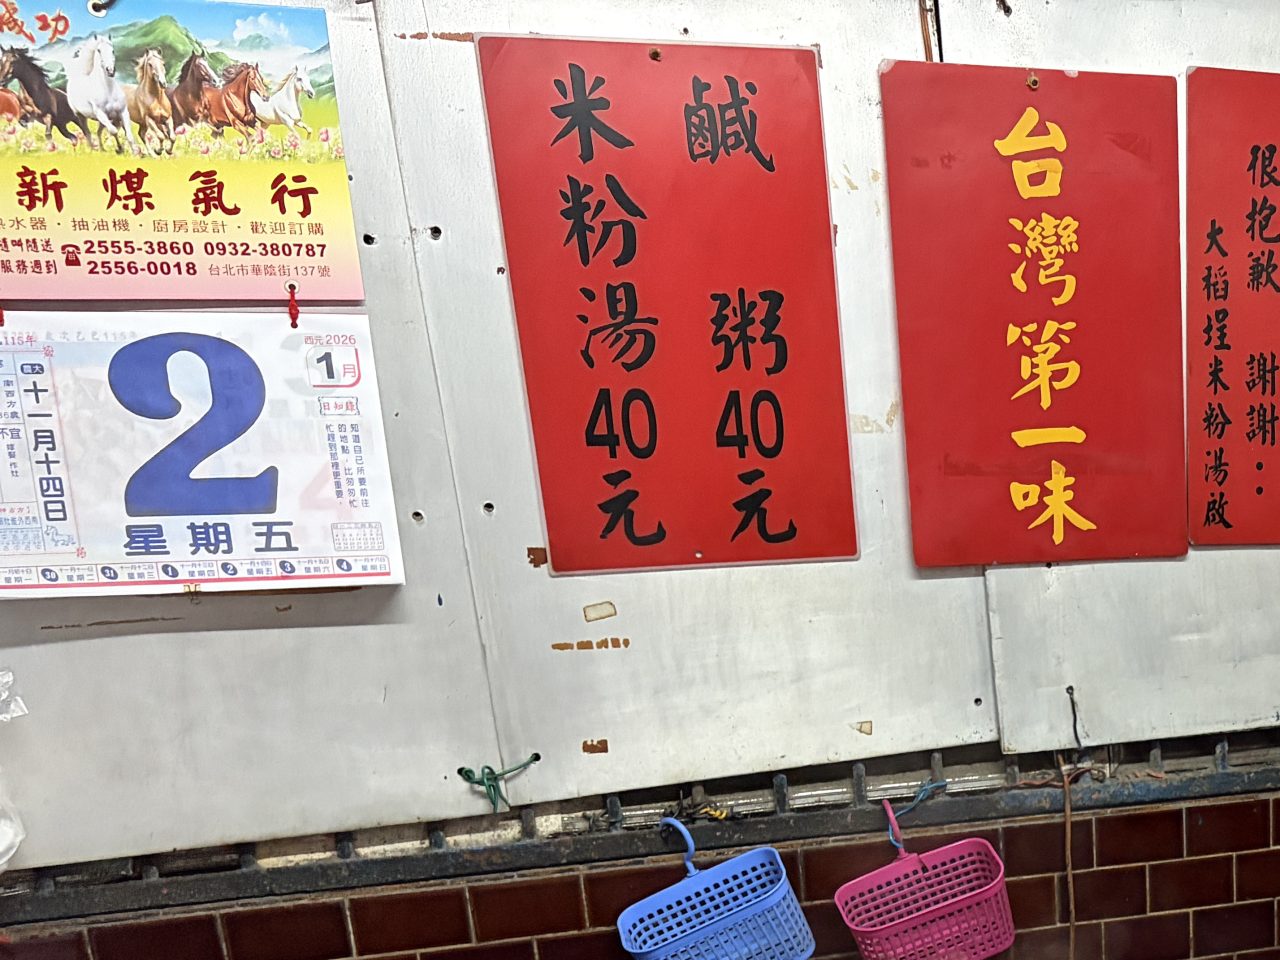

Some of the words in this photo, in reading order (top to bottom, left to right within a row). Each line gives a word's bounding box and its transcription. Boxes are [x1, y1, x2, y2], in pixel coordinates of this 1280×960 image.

[83, 239, 194, 256] 2555-3860
[203, 241, 327, 258] 0932-380787
[86, 260, 198, 276] 2556-0018
[994, 106, 1098, 546] 台灣第一味
[23, 380, 68, 521] 十一月十四日
[108, 331, 278, 517] 2
[124, 521, 300, 556] 星期五
